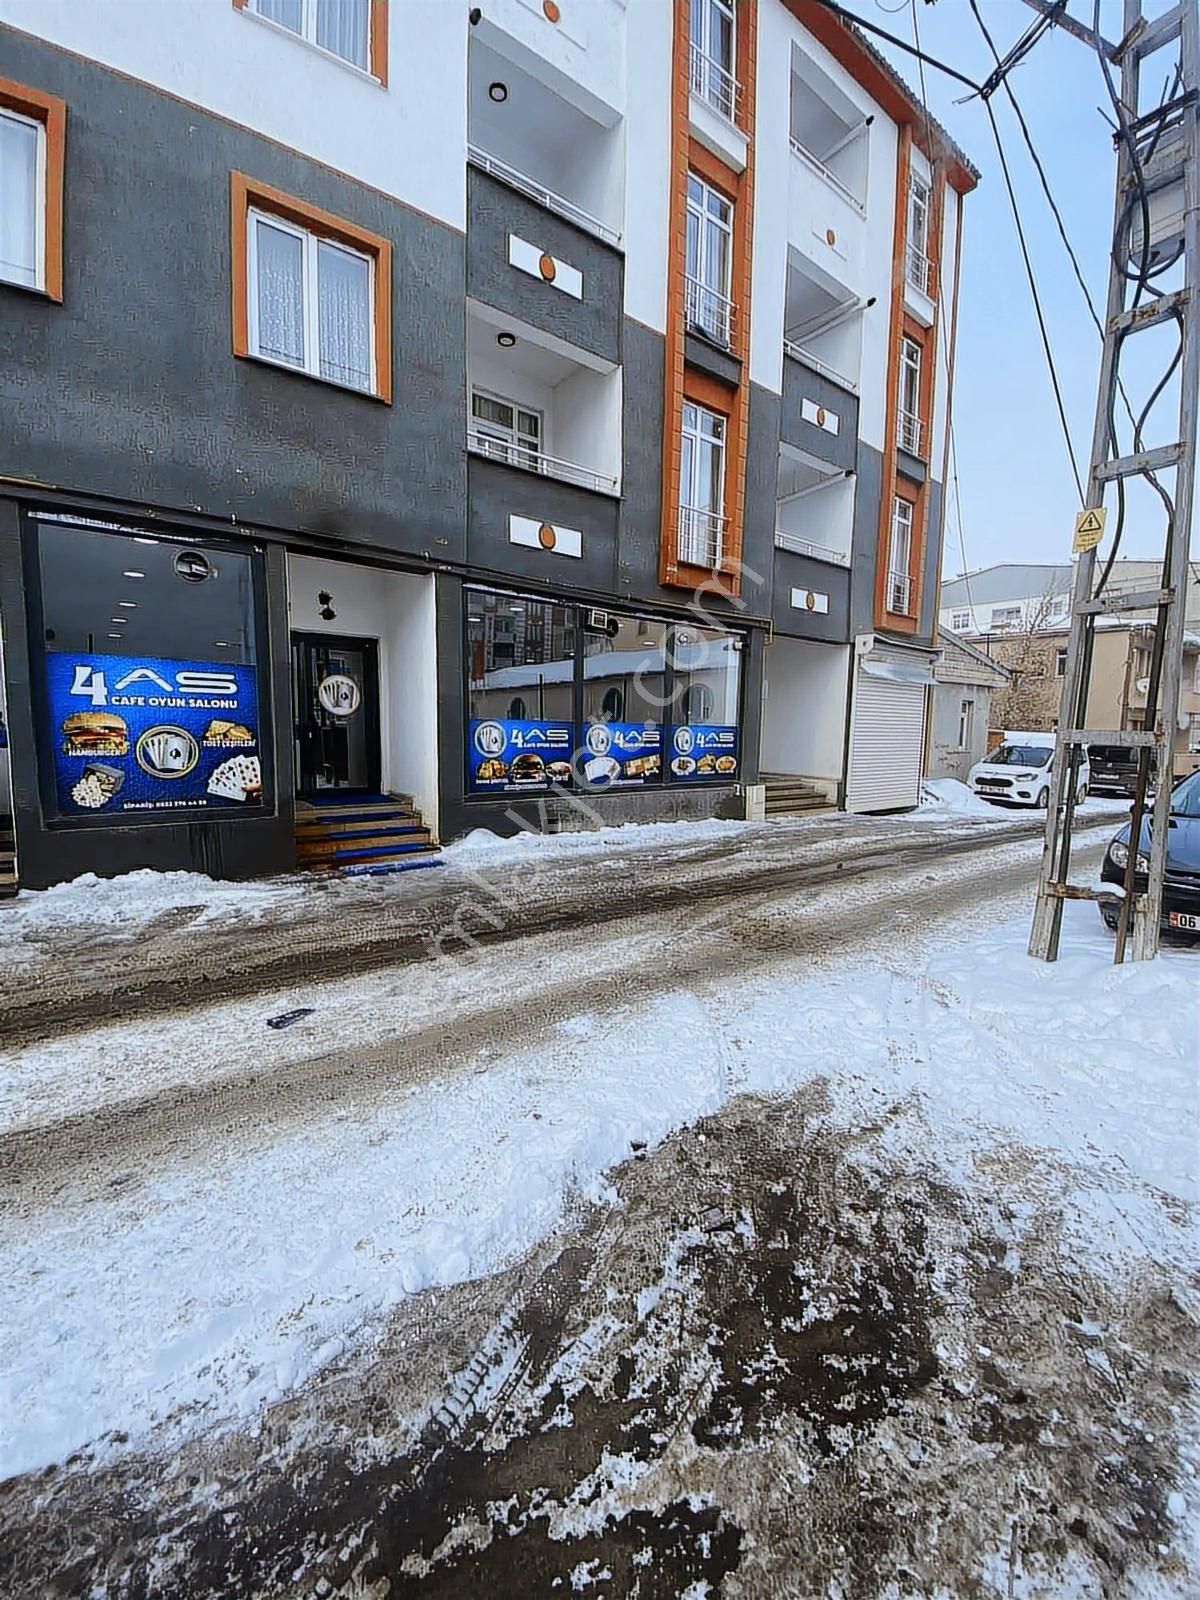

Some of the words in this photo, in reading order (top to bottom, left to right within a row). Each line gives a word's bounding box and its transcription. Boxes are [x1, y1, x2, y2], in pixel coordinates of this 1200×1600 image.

[111, 696, 145, 706] CAFE
[148, 696, 186, 707] OYUN
[189, 698, 238, 709] SALONU
[1179, 915, 1196, 928] 06
